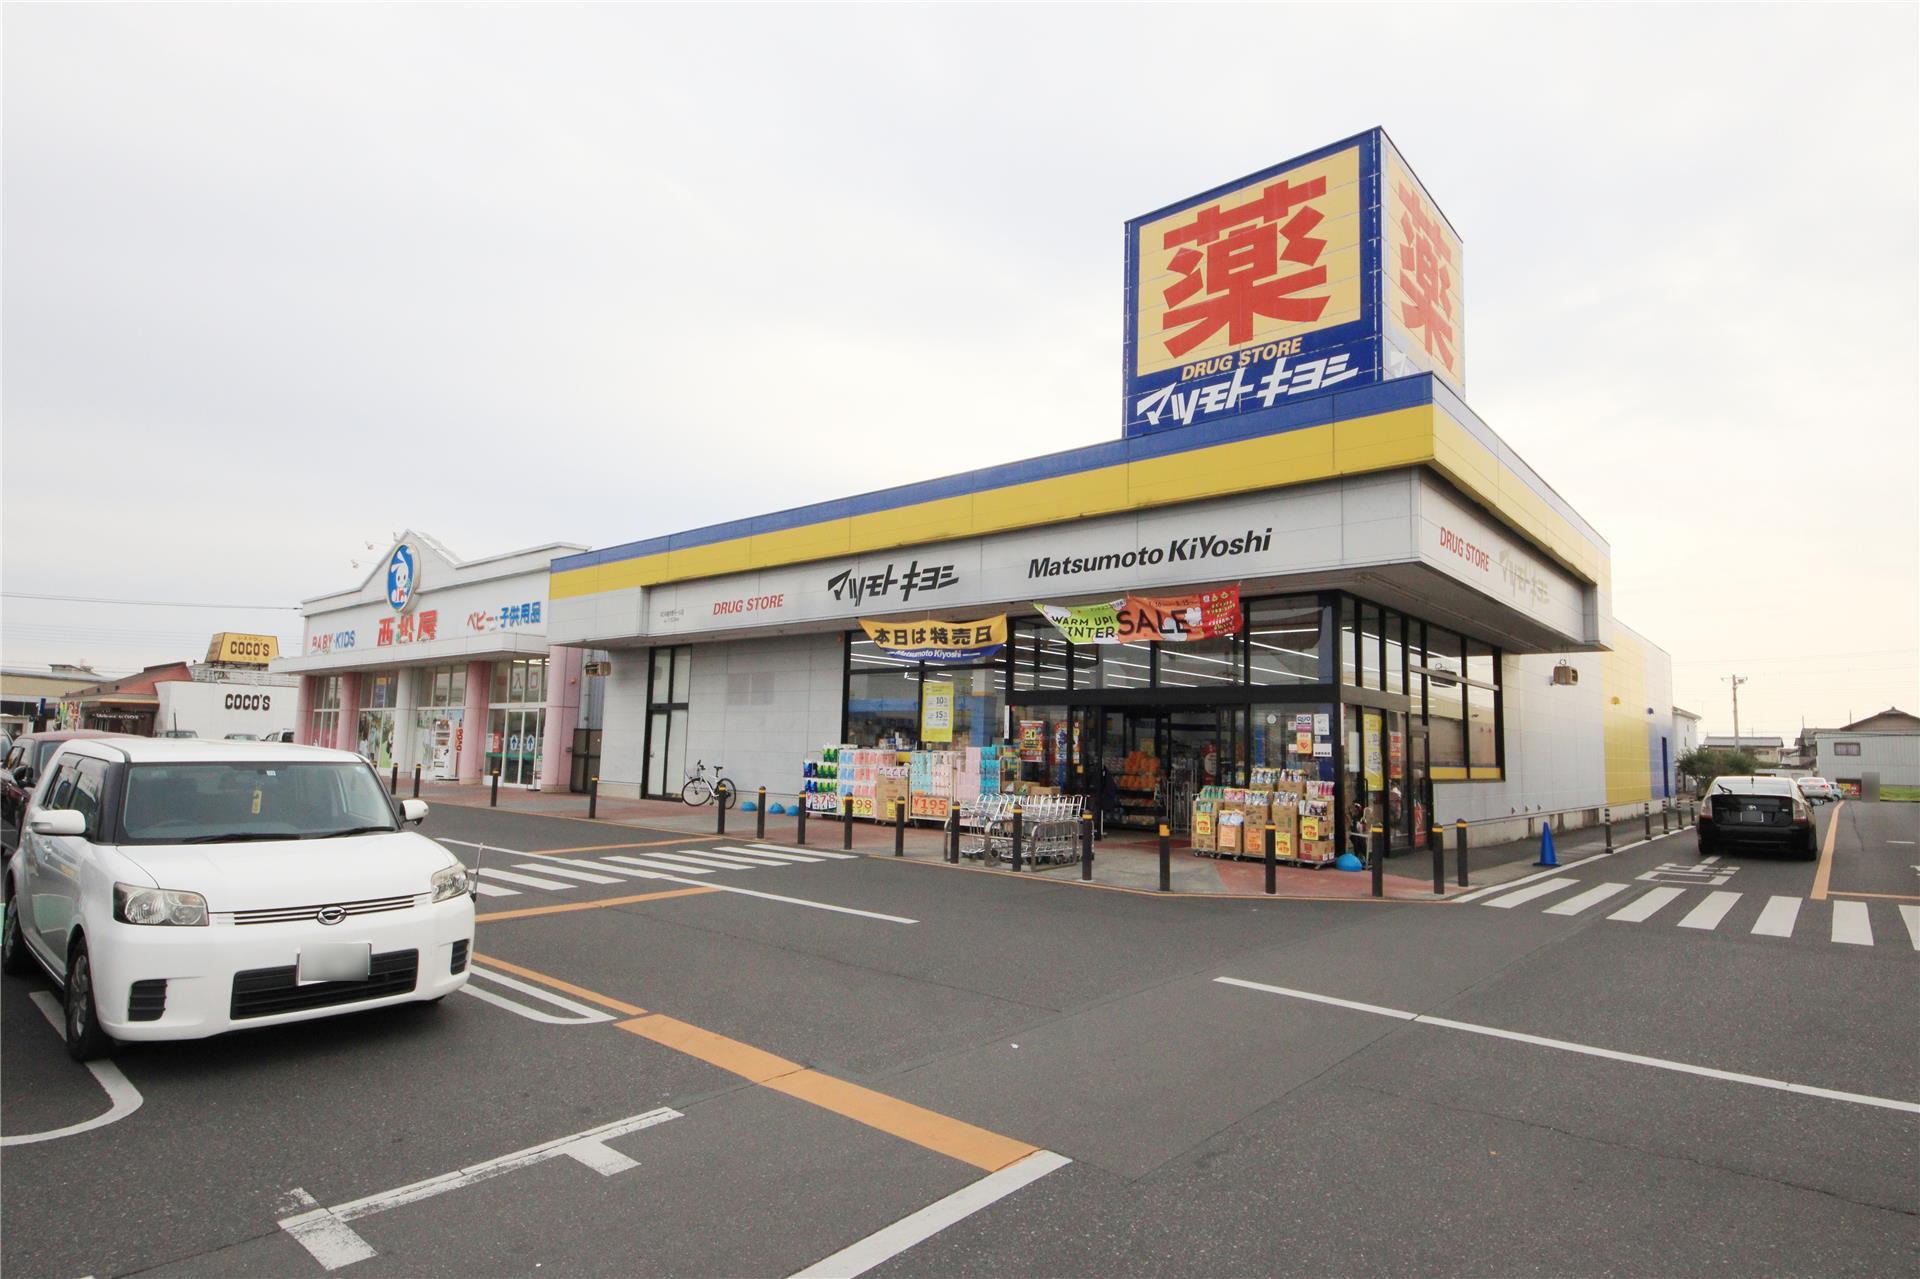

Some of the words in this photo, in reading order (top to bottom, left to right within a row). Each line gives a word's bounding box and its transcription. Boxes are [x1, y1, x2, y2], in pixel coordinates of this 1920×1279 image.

[1163, 175, 1331, 359] 薬
[1398, 180, 1454, 371] 薬
[1181, 355, 1233, 382] DRUG
[1238, 336, 1303, 366] STORE
[1137, 353, 1359, 425] マツモトキヨシ
[1028, 546, 1164, 580] Matsumoto
[1440, 526, 1464, 558] DRUG
[1465, 542, 1490, 572] STORE
[827, 561, 960, 607] マツモトキヨシ
[713, 600, 743, 616] DRUG
[746, 594, 784, 611] STORE
[1052, 615, 1089, 626] WARM
[1094, 615, 1114, 626] UP!
[1067, 626, 1115, 638] INTER
[1116, 608, 1194, 636] SALE
[230, 641, 270, 656] COCO'S
[875, 625, 993, 645] 本日は特売日
[225, 694, 271, 711] COCO'S
[913, 798, 947, 811] ¥195
